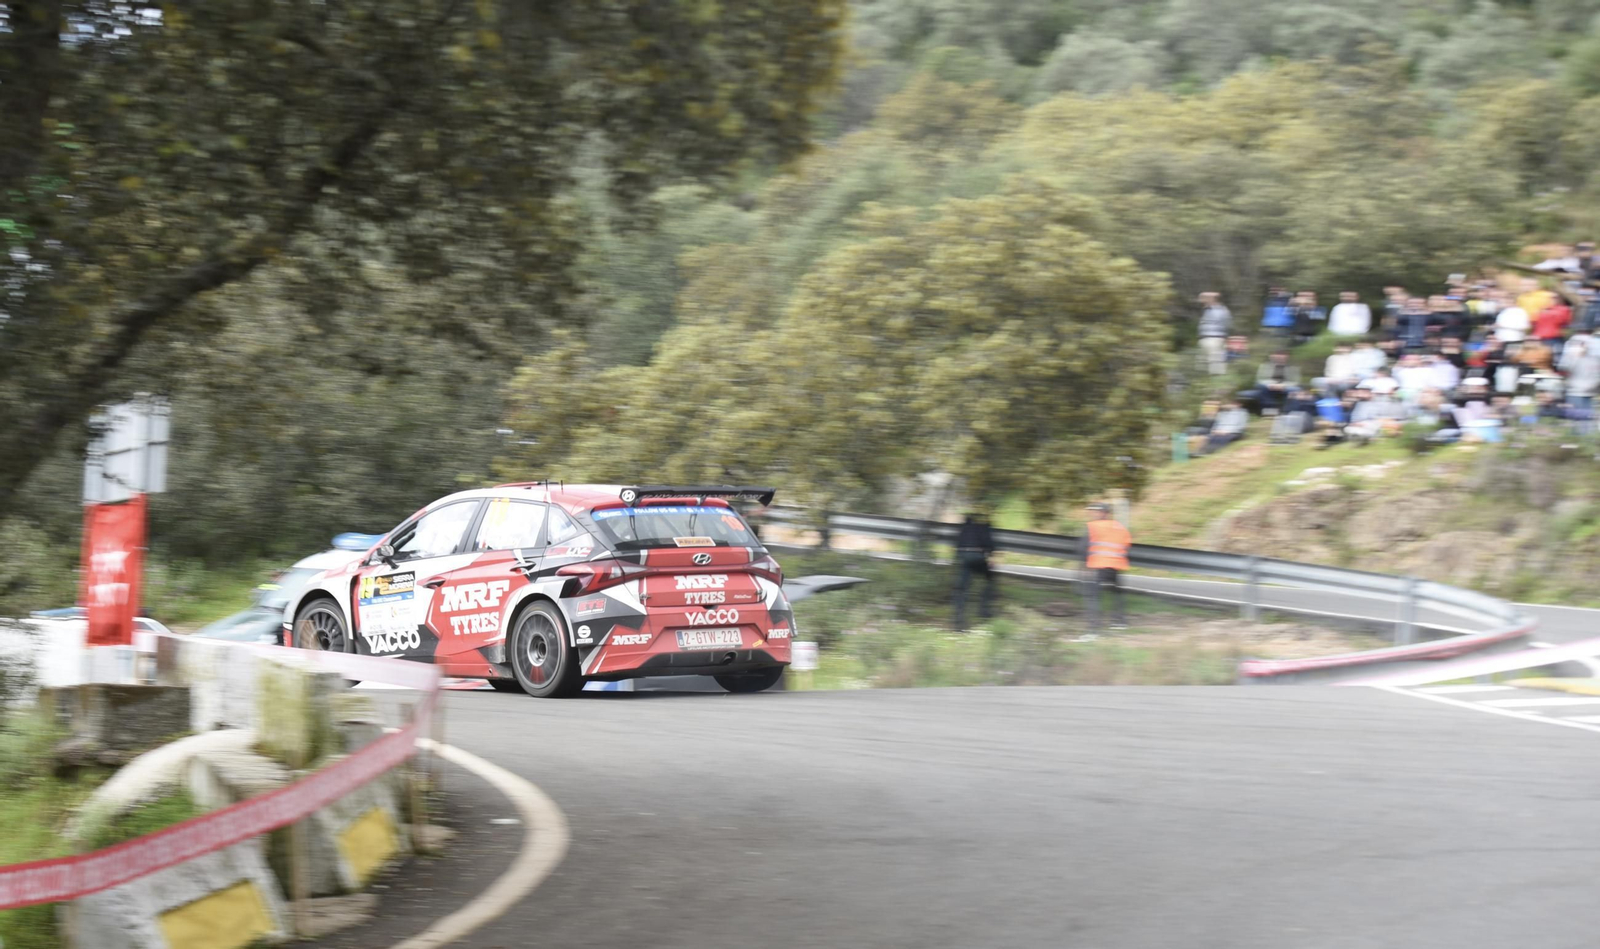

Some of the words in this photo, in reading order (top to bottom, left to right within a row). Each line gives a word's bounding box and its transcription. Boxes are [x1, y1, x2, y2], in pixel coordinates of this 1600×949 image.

[674, 574, 729, 590] MRF
[440, 579, 510, 613] MRF
[684, 591, 726, 604] TYRES
[450, 611, 499, 636] TYRES
[685, 608, 739, 626] YACCO
[365, 629, 421, 654] YACCO
[611, 633, 652, 645] MRF
[684, 630, 740, 645] 2-GTW-223
[767, 628, 790, 639] MRF
